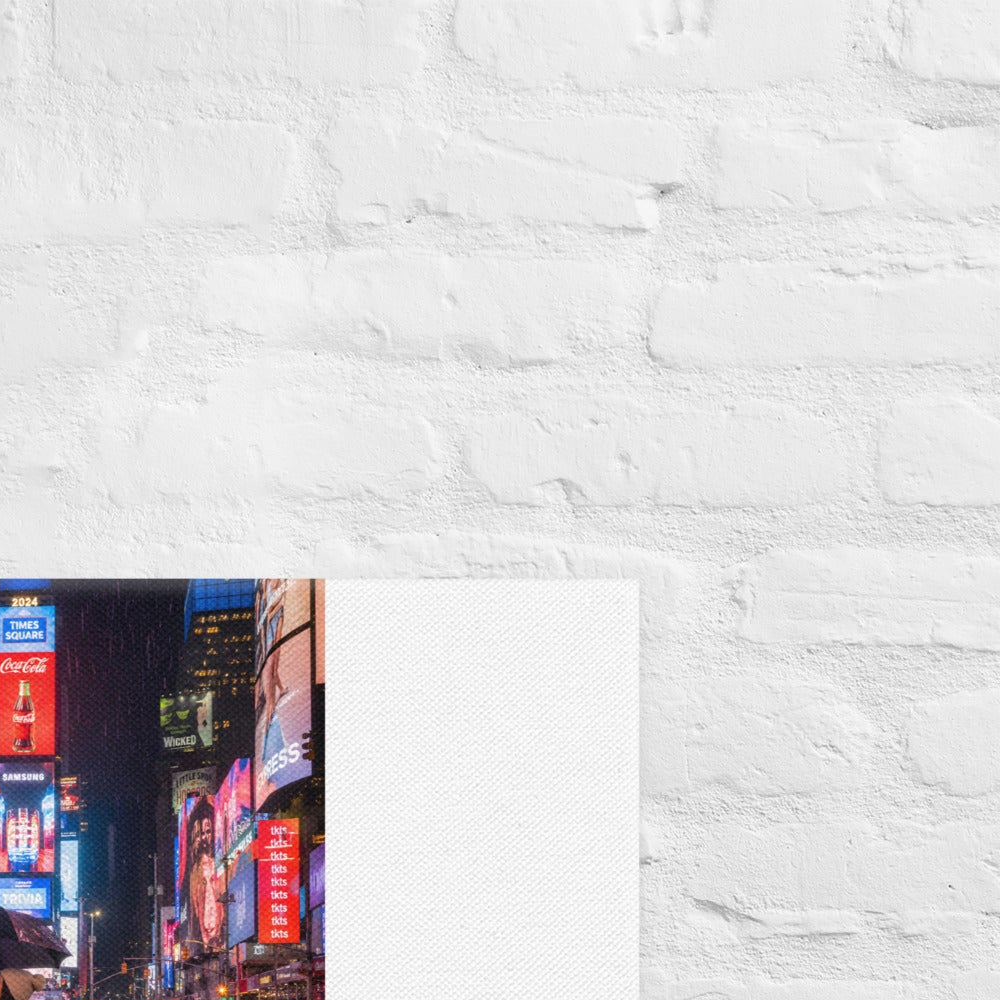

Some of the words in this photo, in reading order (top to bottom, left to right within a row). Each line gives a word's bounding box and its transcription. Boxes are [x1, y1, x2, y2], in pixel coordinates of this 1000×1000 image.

[11, 597, 38, 607] 2024
[10, 620, 39, 630] TIMES
[5, 630, 44, 641] SQUARE
[0, 657, 49, 674] Coca-Cola
[163, 735, 197, 748] WICKED
[2, 773, 44, 781] SAMSUNG
[271, 825, 287, 835] tkts
[270, 838, 287, 848] tkts
[270, 851, 287, 861] tkts
[271, 864, 287, 874] tkts
[271, 877, 287, 887] tkts
[271, 890, 288, 900] tkts
[271, 902, 287, 913] tkts
[271, 915, 287, 926] tkts
[271, 928, 288, 939] tkts
